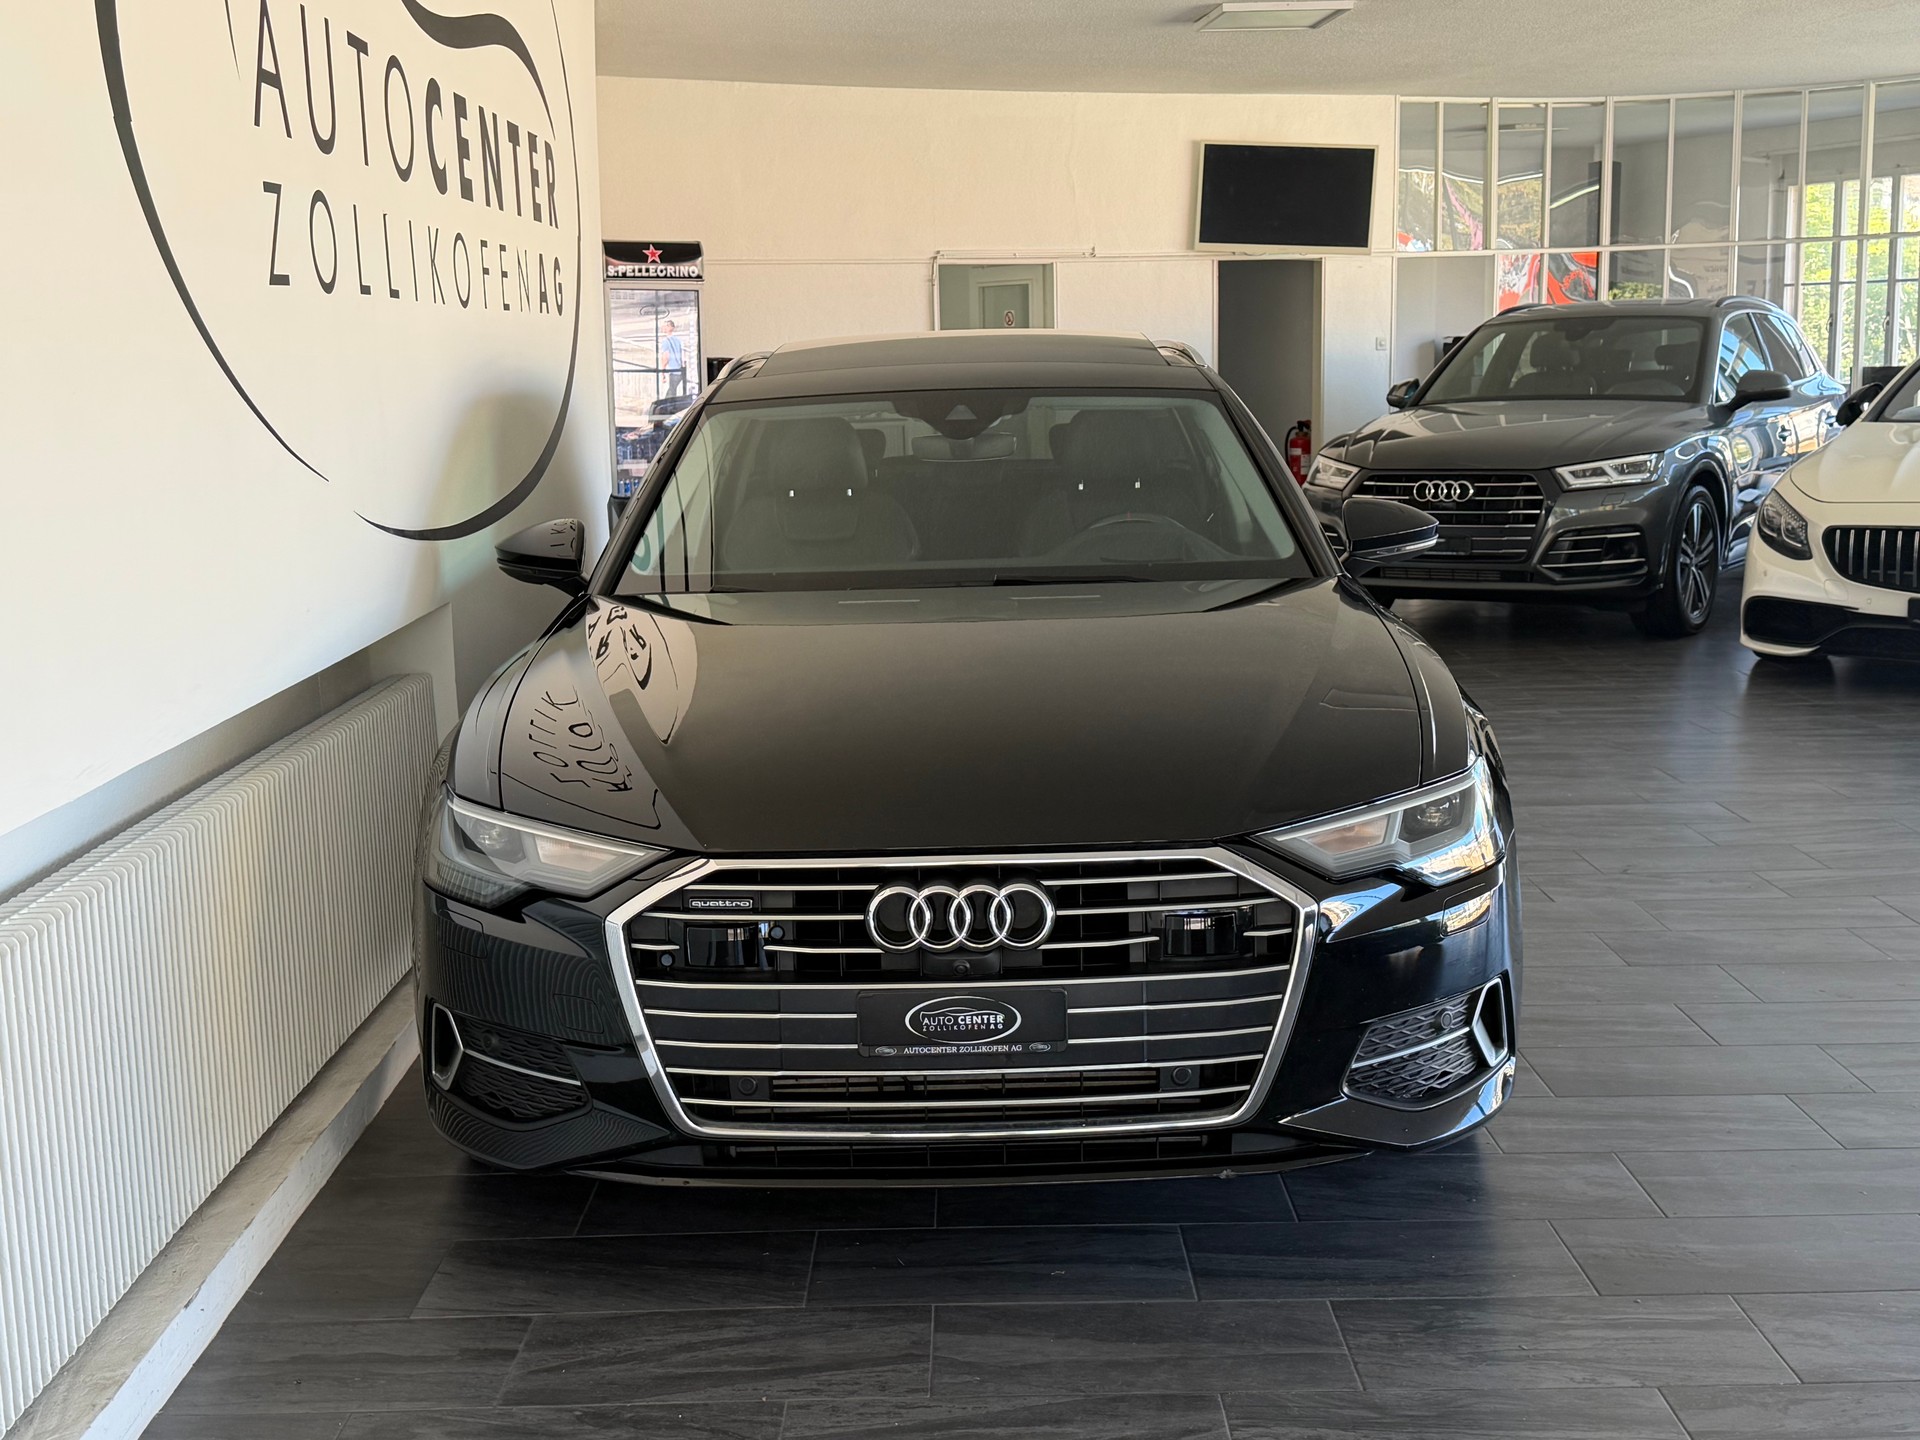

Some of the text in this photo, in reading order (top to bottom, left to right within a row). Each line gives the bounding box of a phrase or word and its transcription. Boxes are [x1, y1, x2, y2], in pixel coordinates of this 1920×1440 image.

[691, 900, 750, 908] quattro
[922, 1014, 1004, 1026] AUTO CENTER
[922, 1024, 986, 1032] ZOLLIKOFEN
[903, 1046, 957, 1054] AUTOCENTER
[959, 1044, 1009, 1053] ZOLLIKOFEN
[1011, 1044, 1023, 1052] AG
